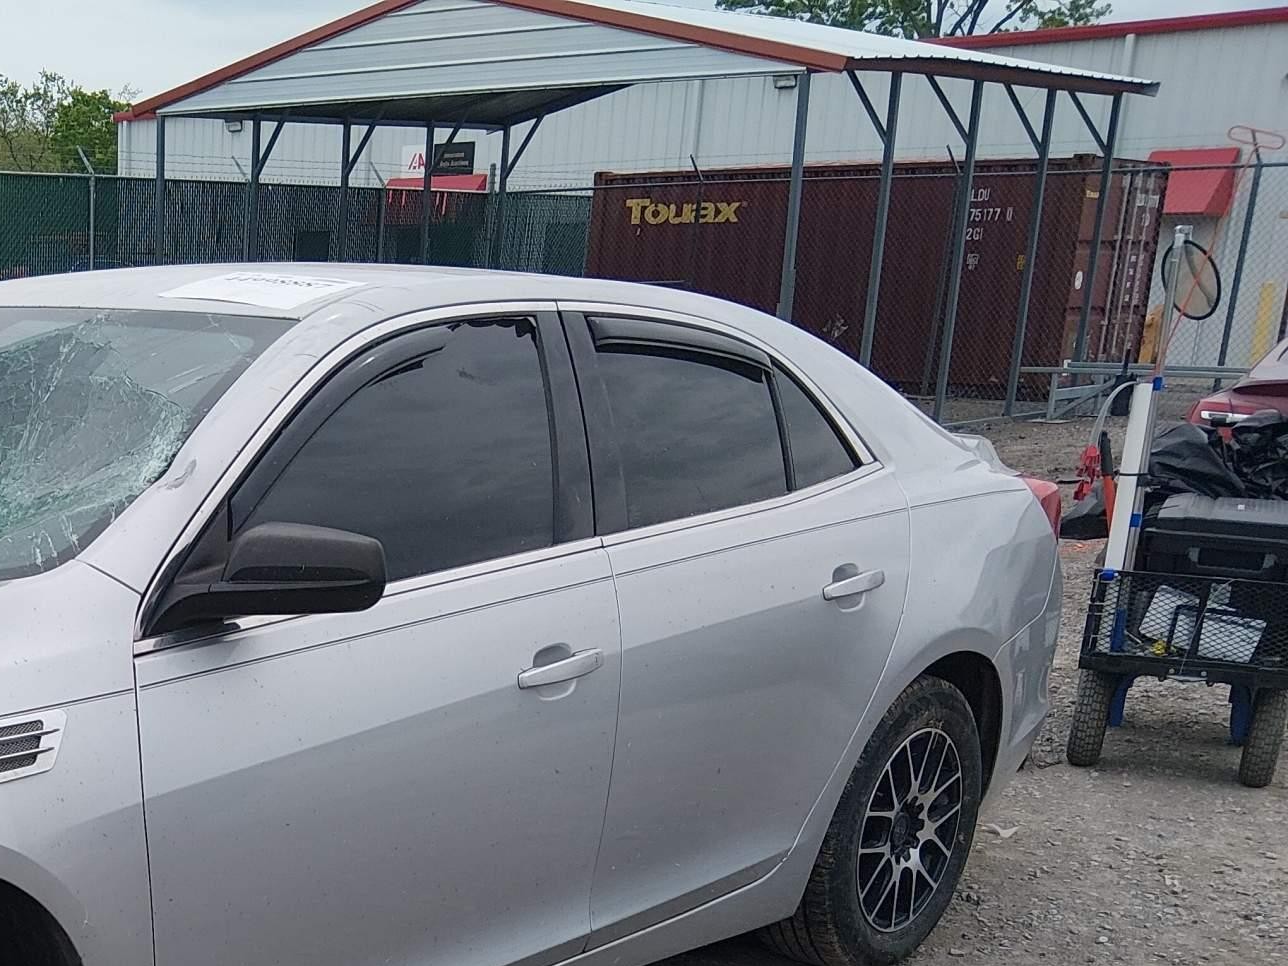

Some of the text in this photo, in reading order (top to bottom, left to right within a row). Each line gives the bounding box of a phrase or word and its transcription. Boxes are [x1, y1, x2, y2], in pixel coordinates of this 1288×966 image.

[970, 187, 991, 202] LDU
[970, 207, 1001, 221] 75177
[966, 227, 984, 241] 2G1
